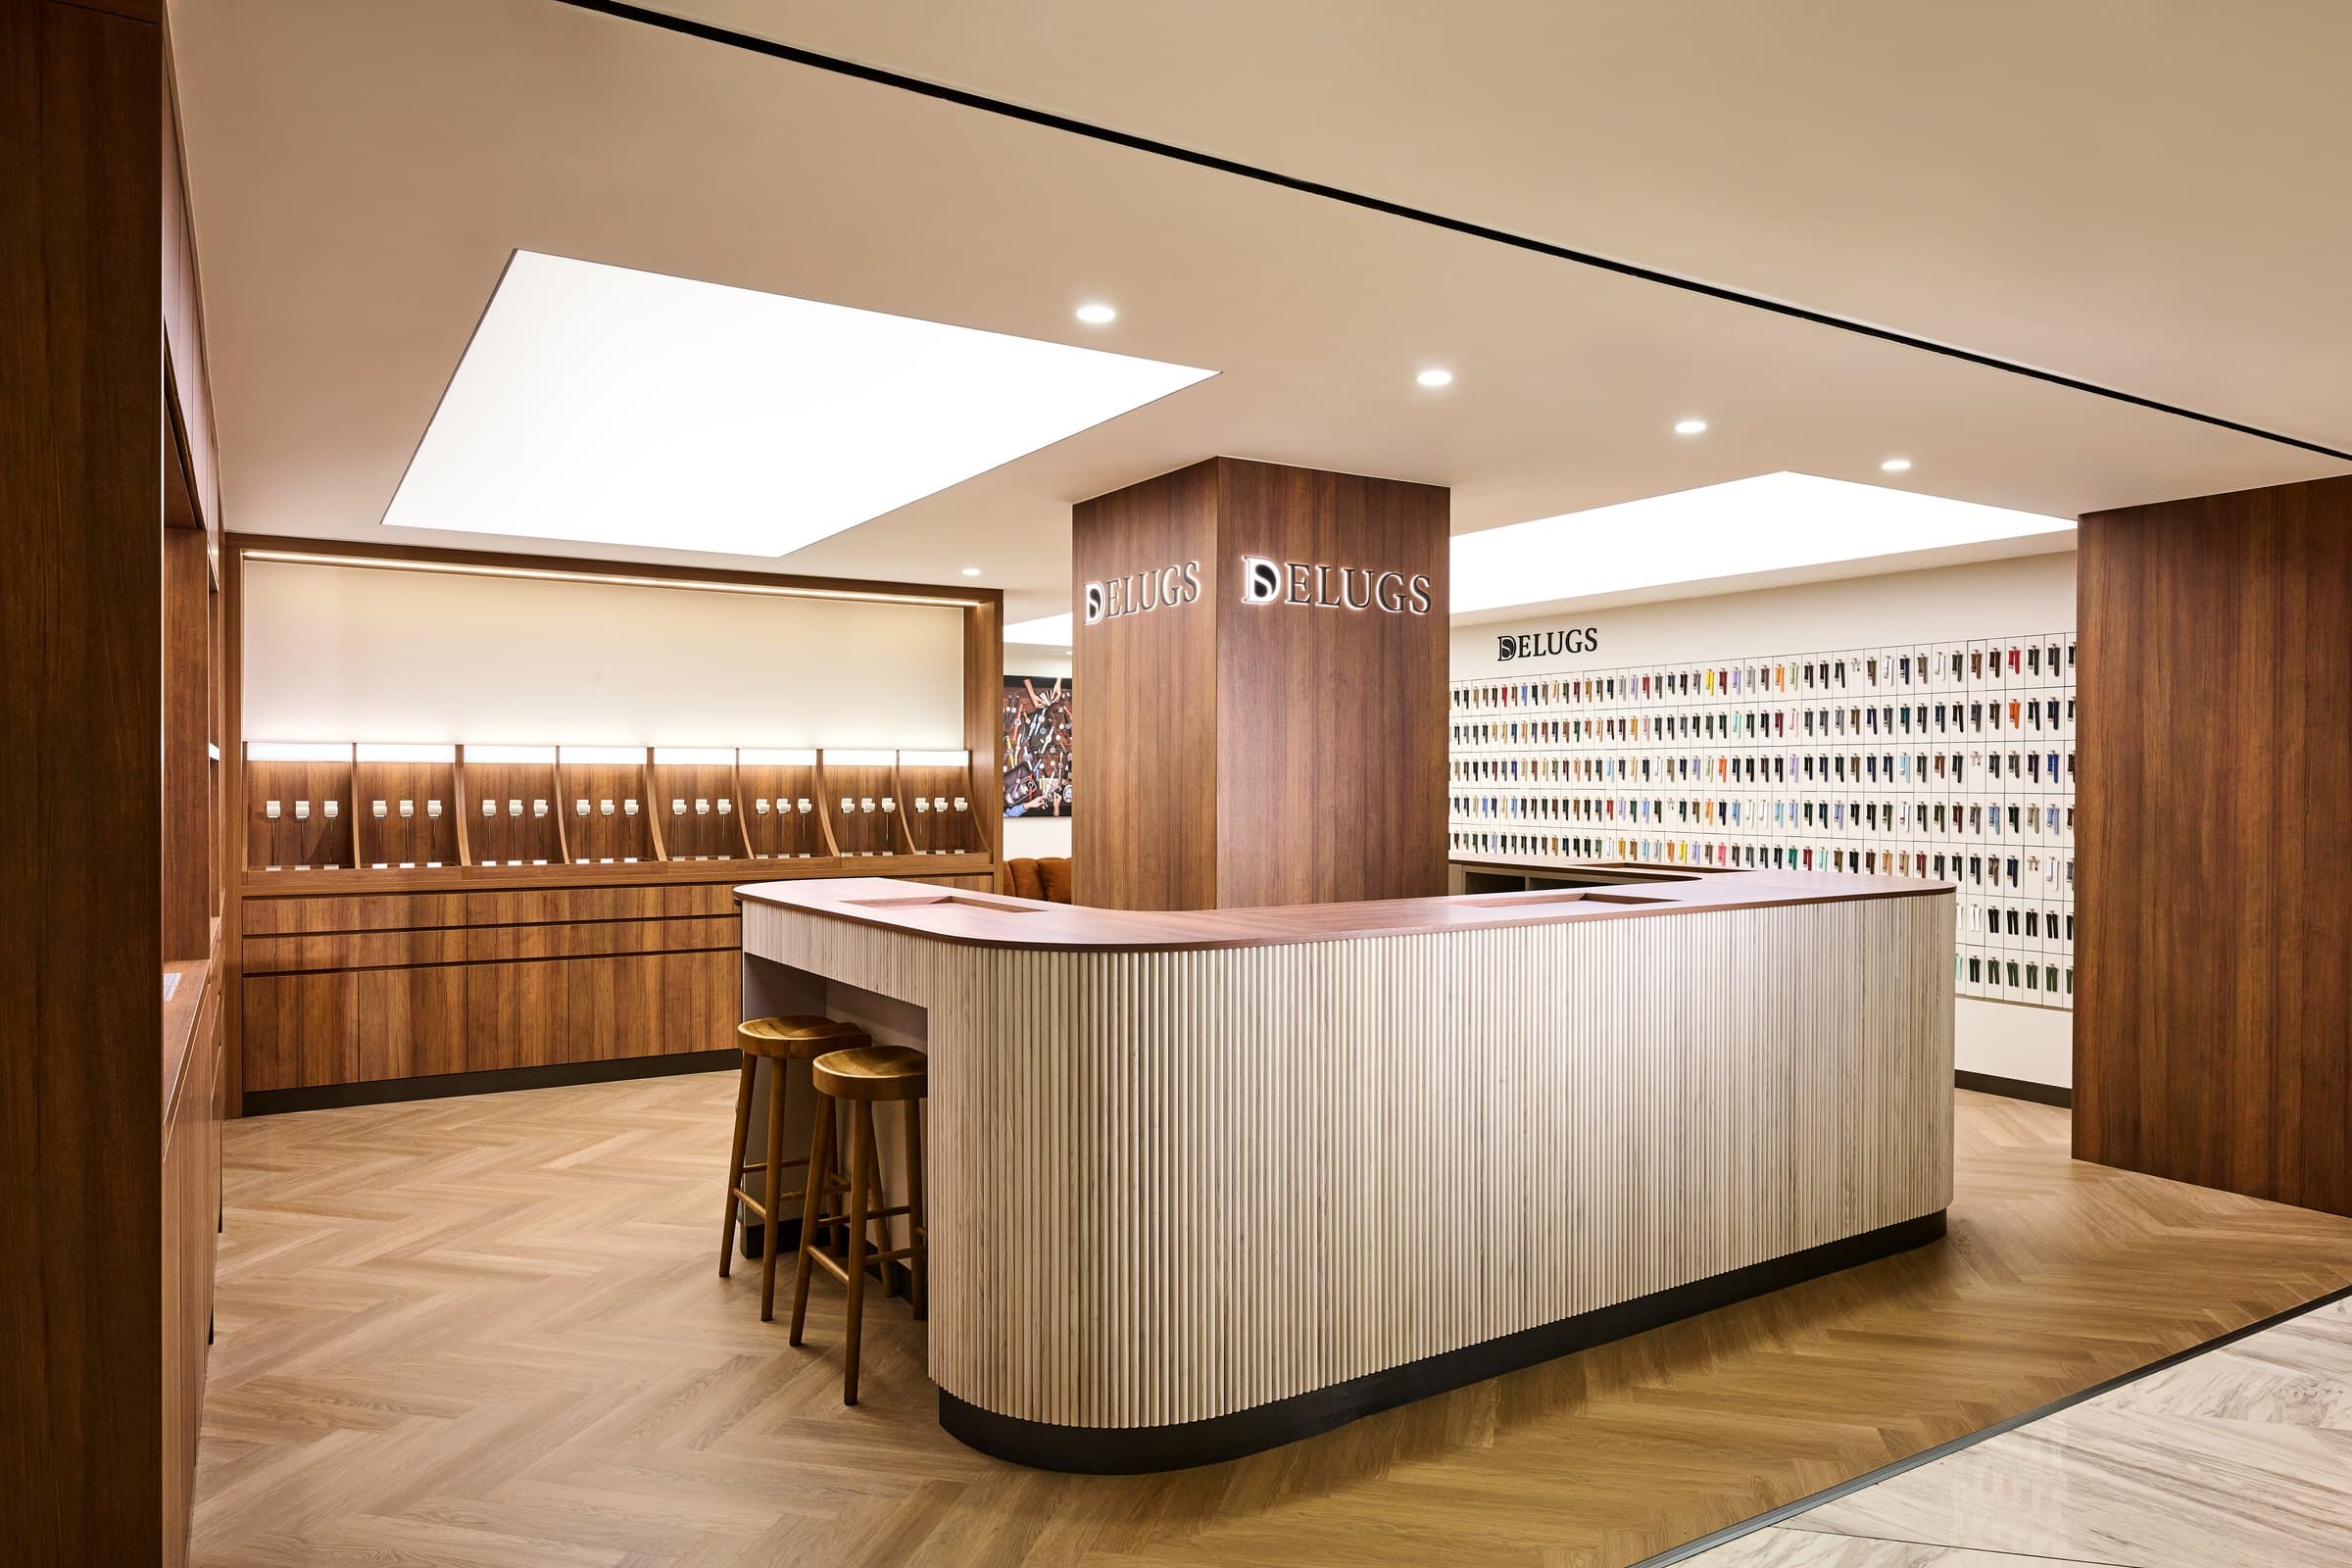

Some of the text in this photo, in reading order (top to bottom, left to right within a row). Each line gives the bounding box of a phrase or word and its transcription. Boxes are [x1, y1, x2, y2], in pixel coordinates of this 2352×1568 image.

[1084, 561, 1200, 625] DELUGS
[1243, 556, 1432, 614] DELUGS
[1496, 627, 1598, 662] DELUGS
